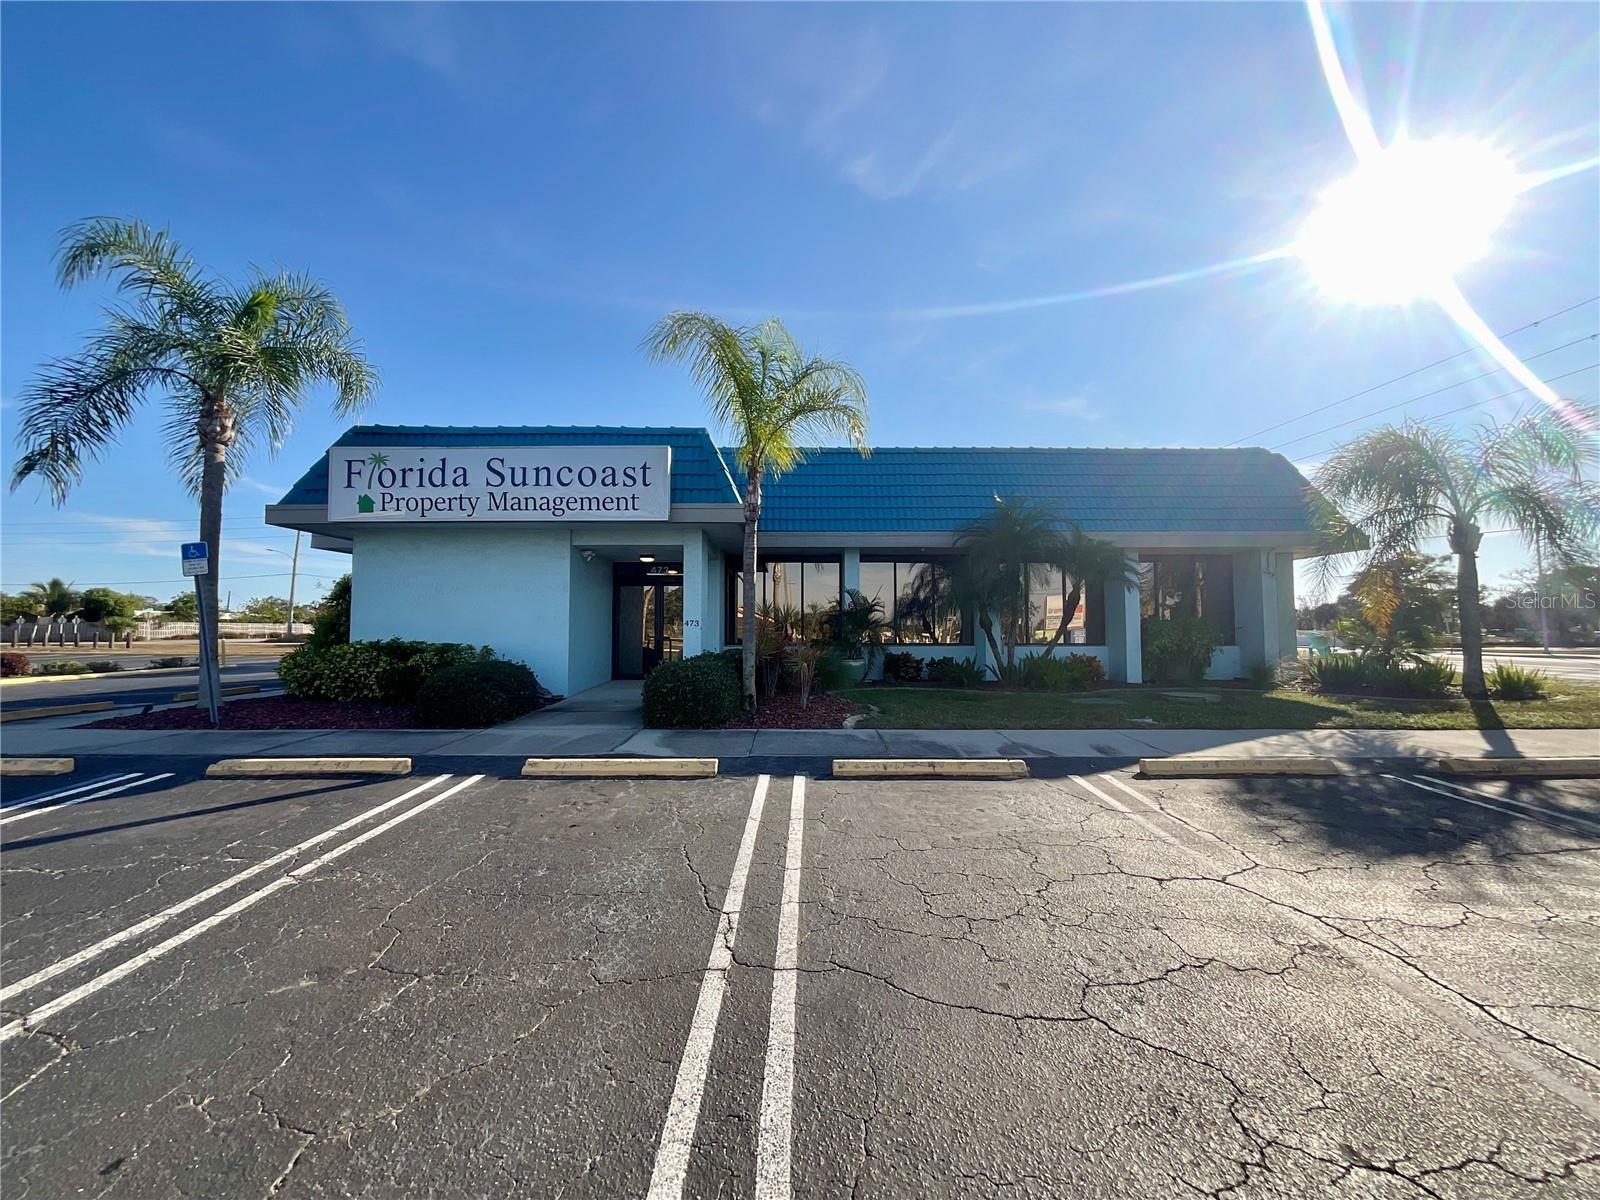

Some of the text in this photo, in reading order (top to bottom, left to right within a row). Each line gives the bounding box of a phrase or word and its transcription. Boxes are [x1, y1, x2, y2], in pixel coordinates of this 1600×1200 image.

[344, 454, 652, 489] Florida Suncoast
[380, 491, 640, 518] Property Management
[684, 619, 700, 627] 473
